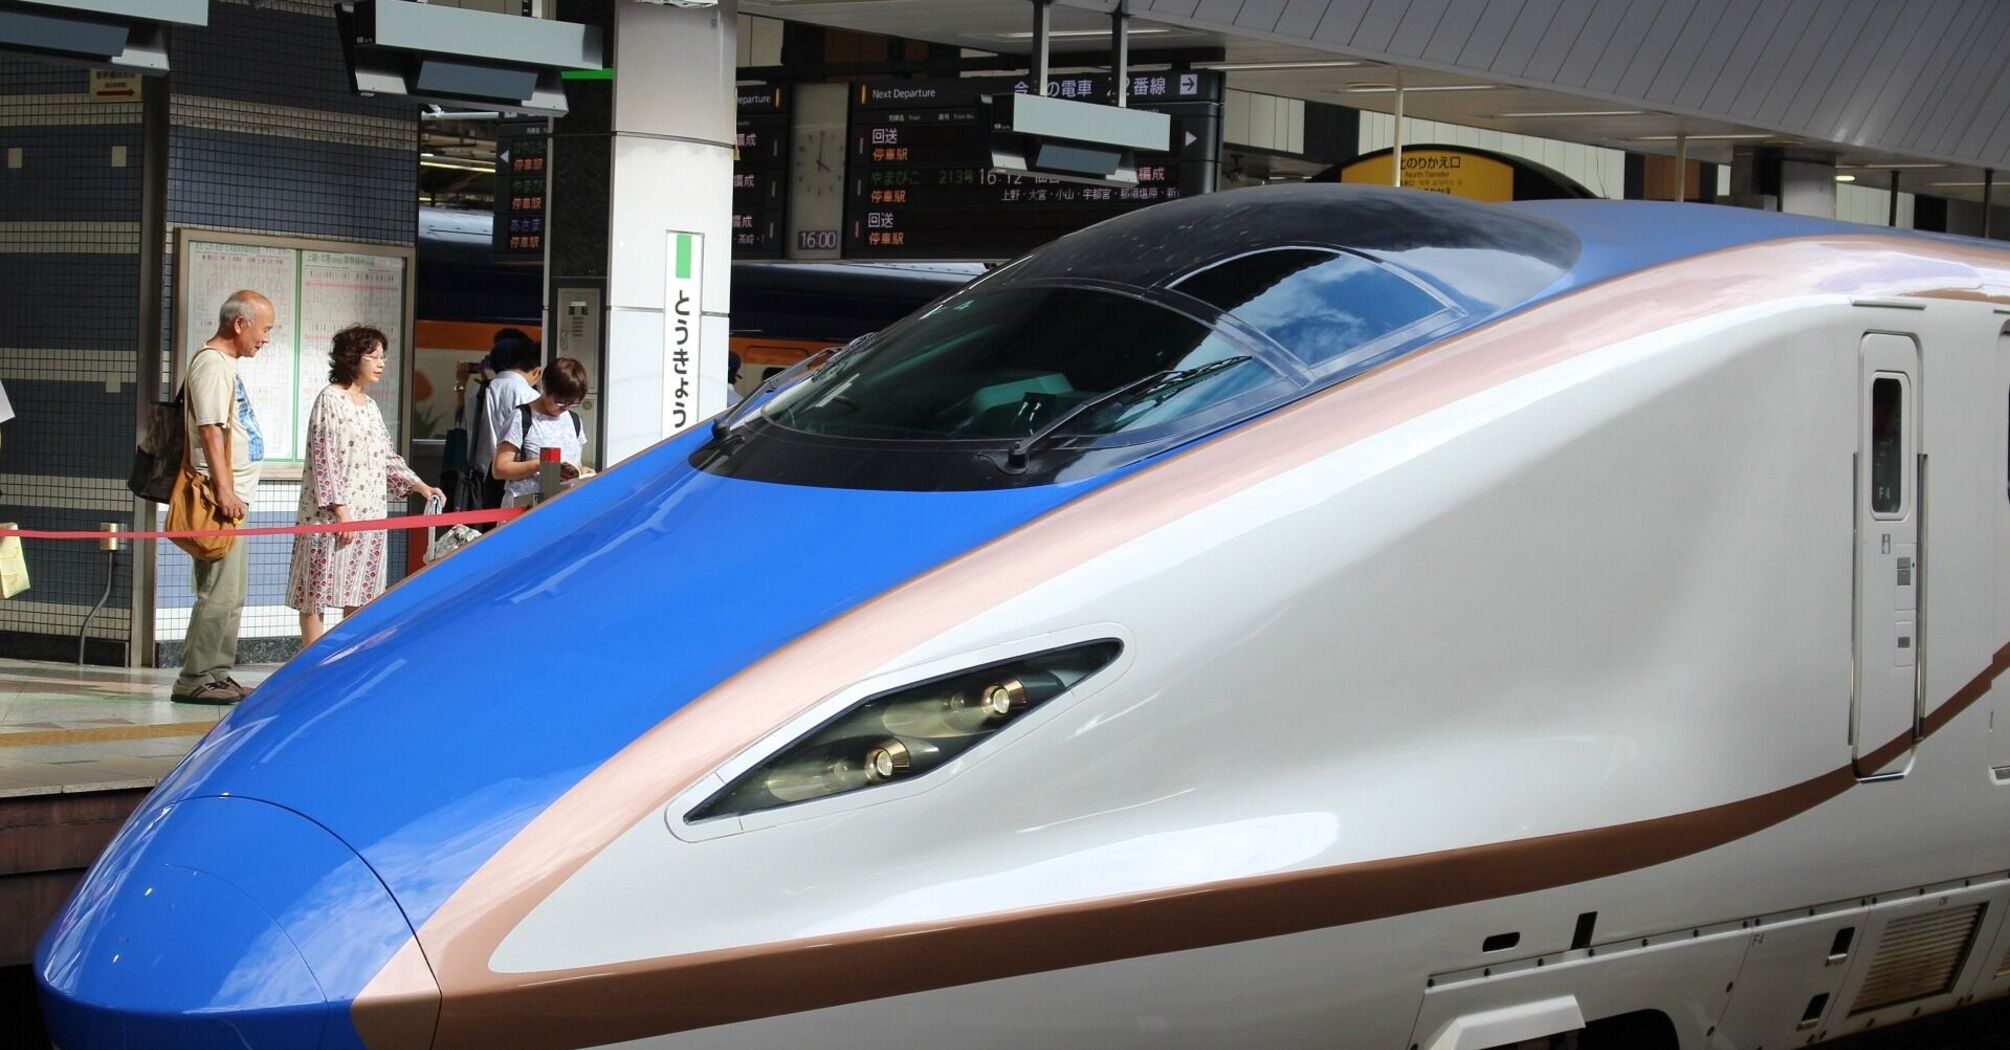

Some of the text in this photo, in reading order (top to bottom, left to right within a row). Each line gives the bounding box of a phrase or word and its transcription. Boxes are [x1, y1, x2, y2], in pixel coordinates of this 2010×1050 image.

[872, 88, 936, 100] Next Departure
[1014, 81, 1092, 98] 今の電車
[738, 94, 771, 105] eparture
[871, 128, 898, 144] 回送
[872, 148, 909, 160] 停車駅
[871, 170, 920, 185] やまびこ
[871, 190, 906, 203] 停車駅
[867, 212, 894, 228] 回送
[801, 231, 837, 249] 16:00
[869, 232, 904, 245] 停車駅
[673, 290, 690, 428] とうきょう
